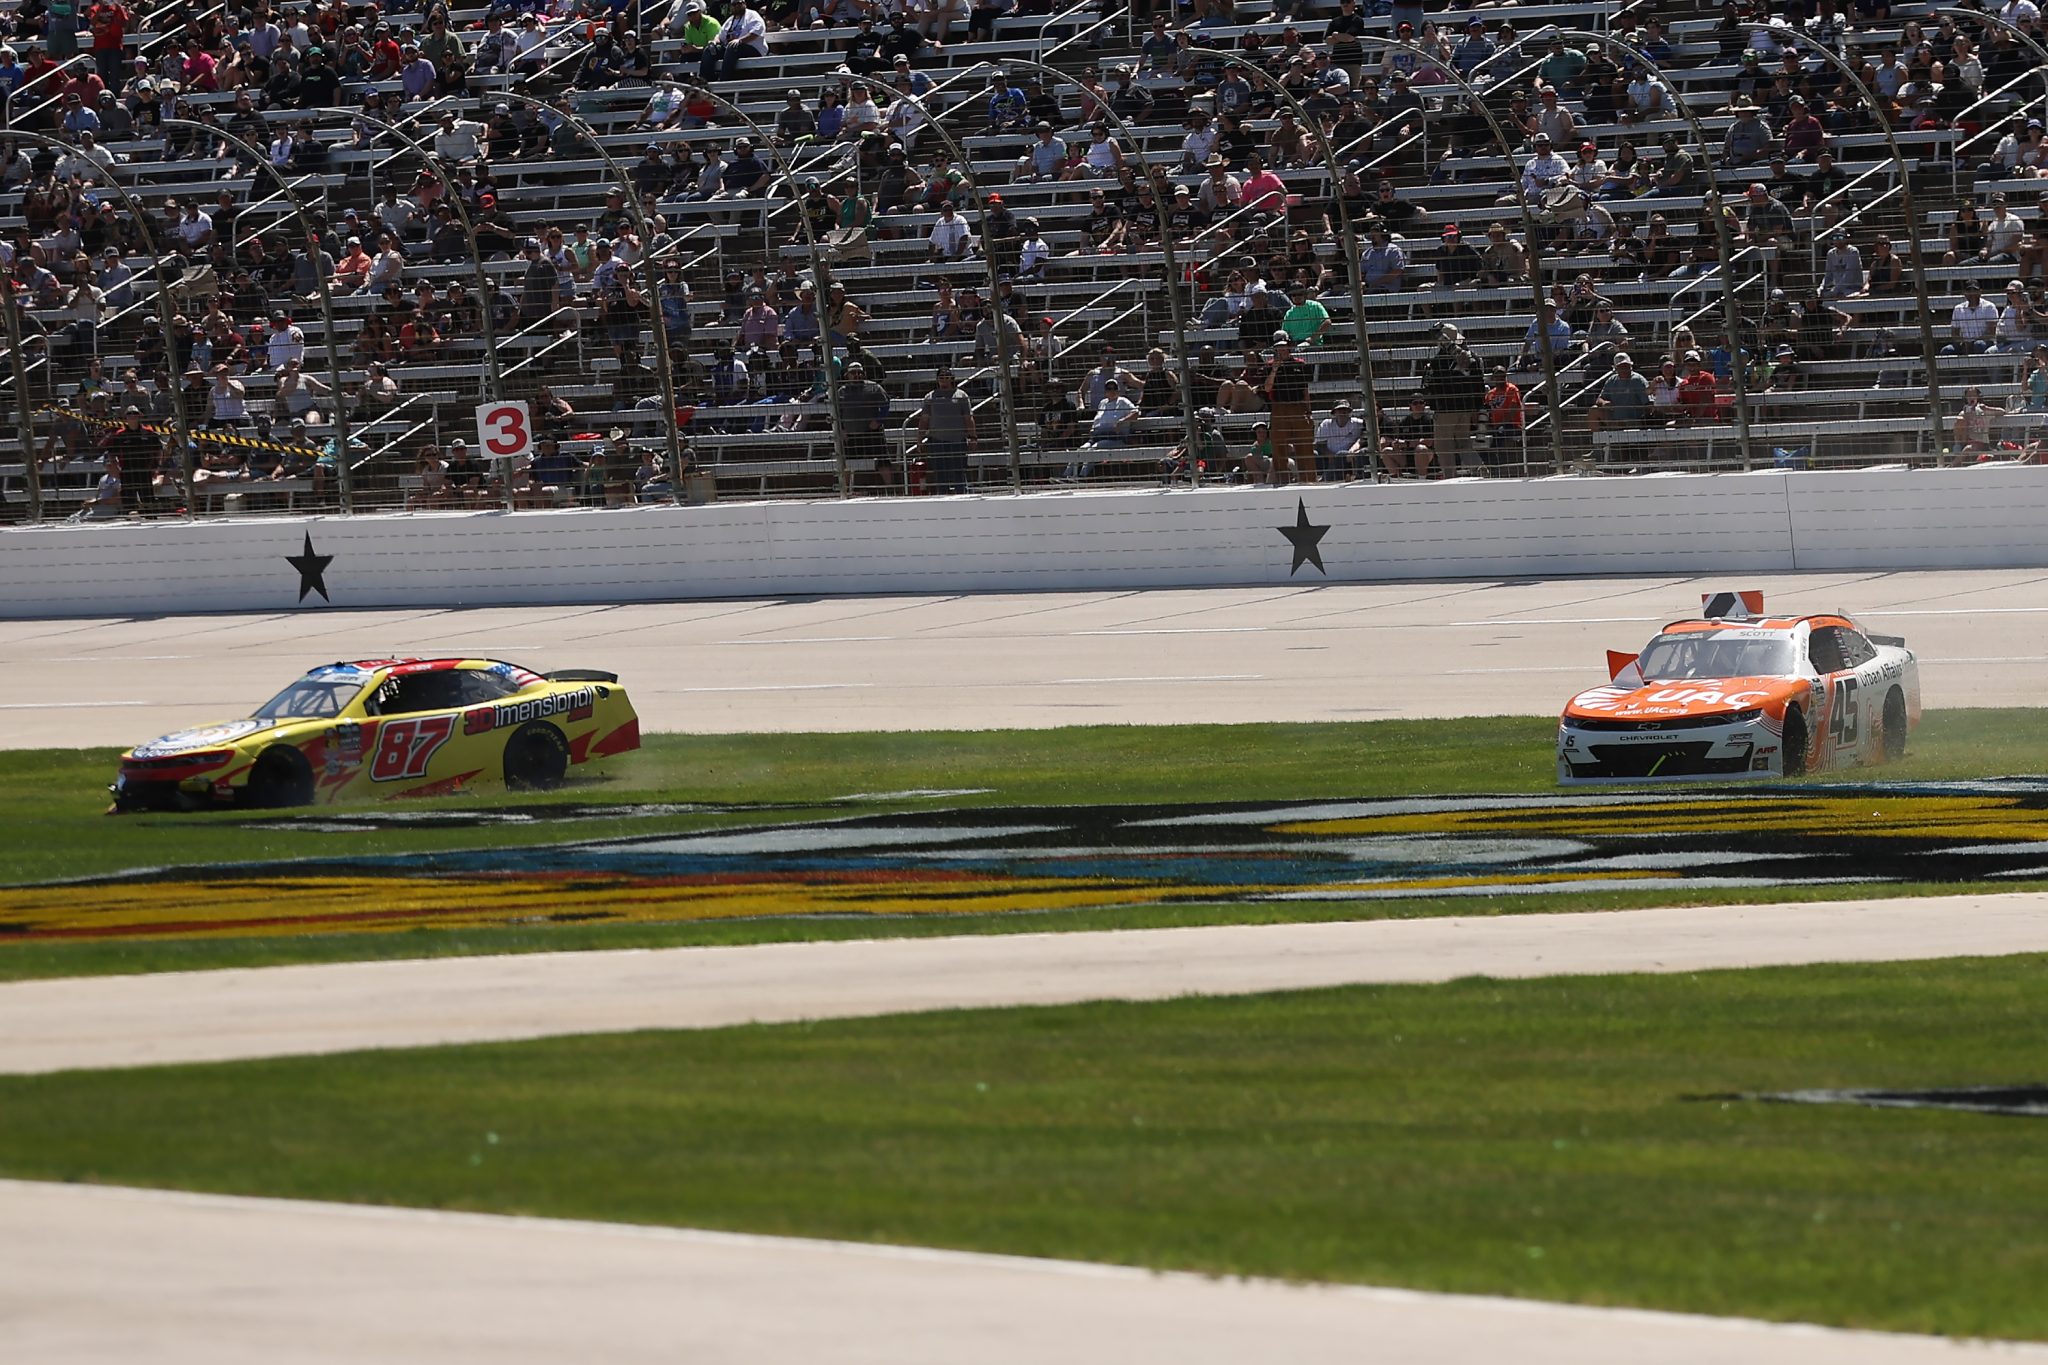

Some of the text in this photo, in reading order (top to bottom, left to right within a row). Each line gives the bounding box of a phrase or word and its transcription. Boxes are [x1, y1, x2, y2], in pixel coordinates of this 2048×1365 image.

[485, 407, 527, 455] 3
[1860, 669, 1883, 687] Urban
[1646, 689, 1770, 710] UAC
[463, 686, 594, 736] 3Dimensional
[1615, 706, 1689, 717] www.UAC.org
[1829, 677, 1858, 746] 45
[371, 713, 459, 782] 87
[1565, 736, 1576, 747] 45
[1619, 733, 1679, 741] CHEVROLET
